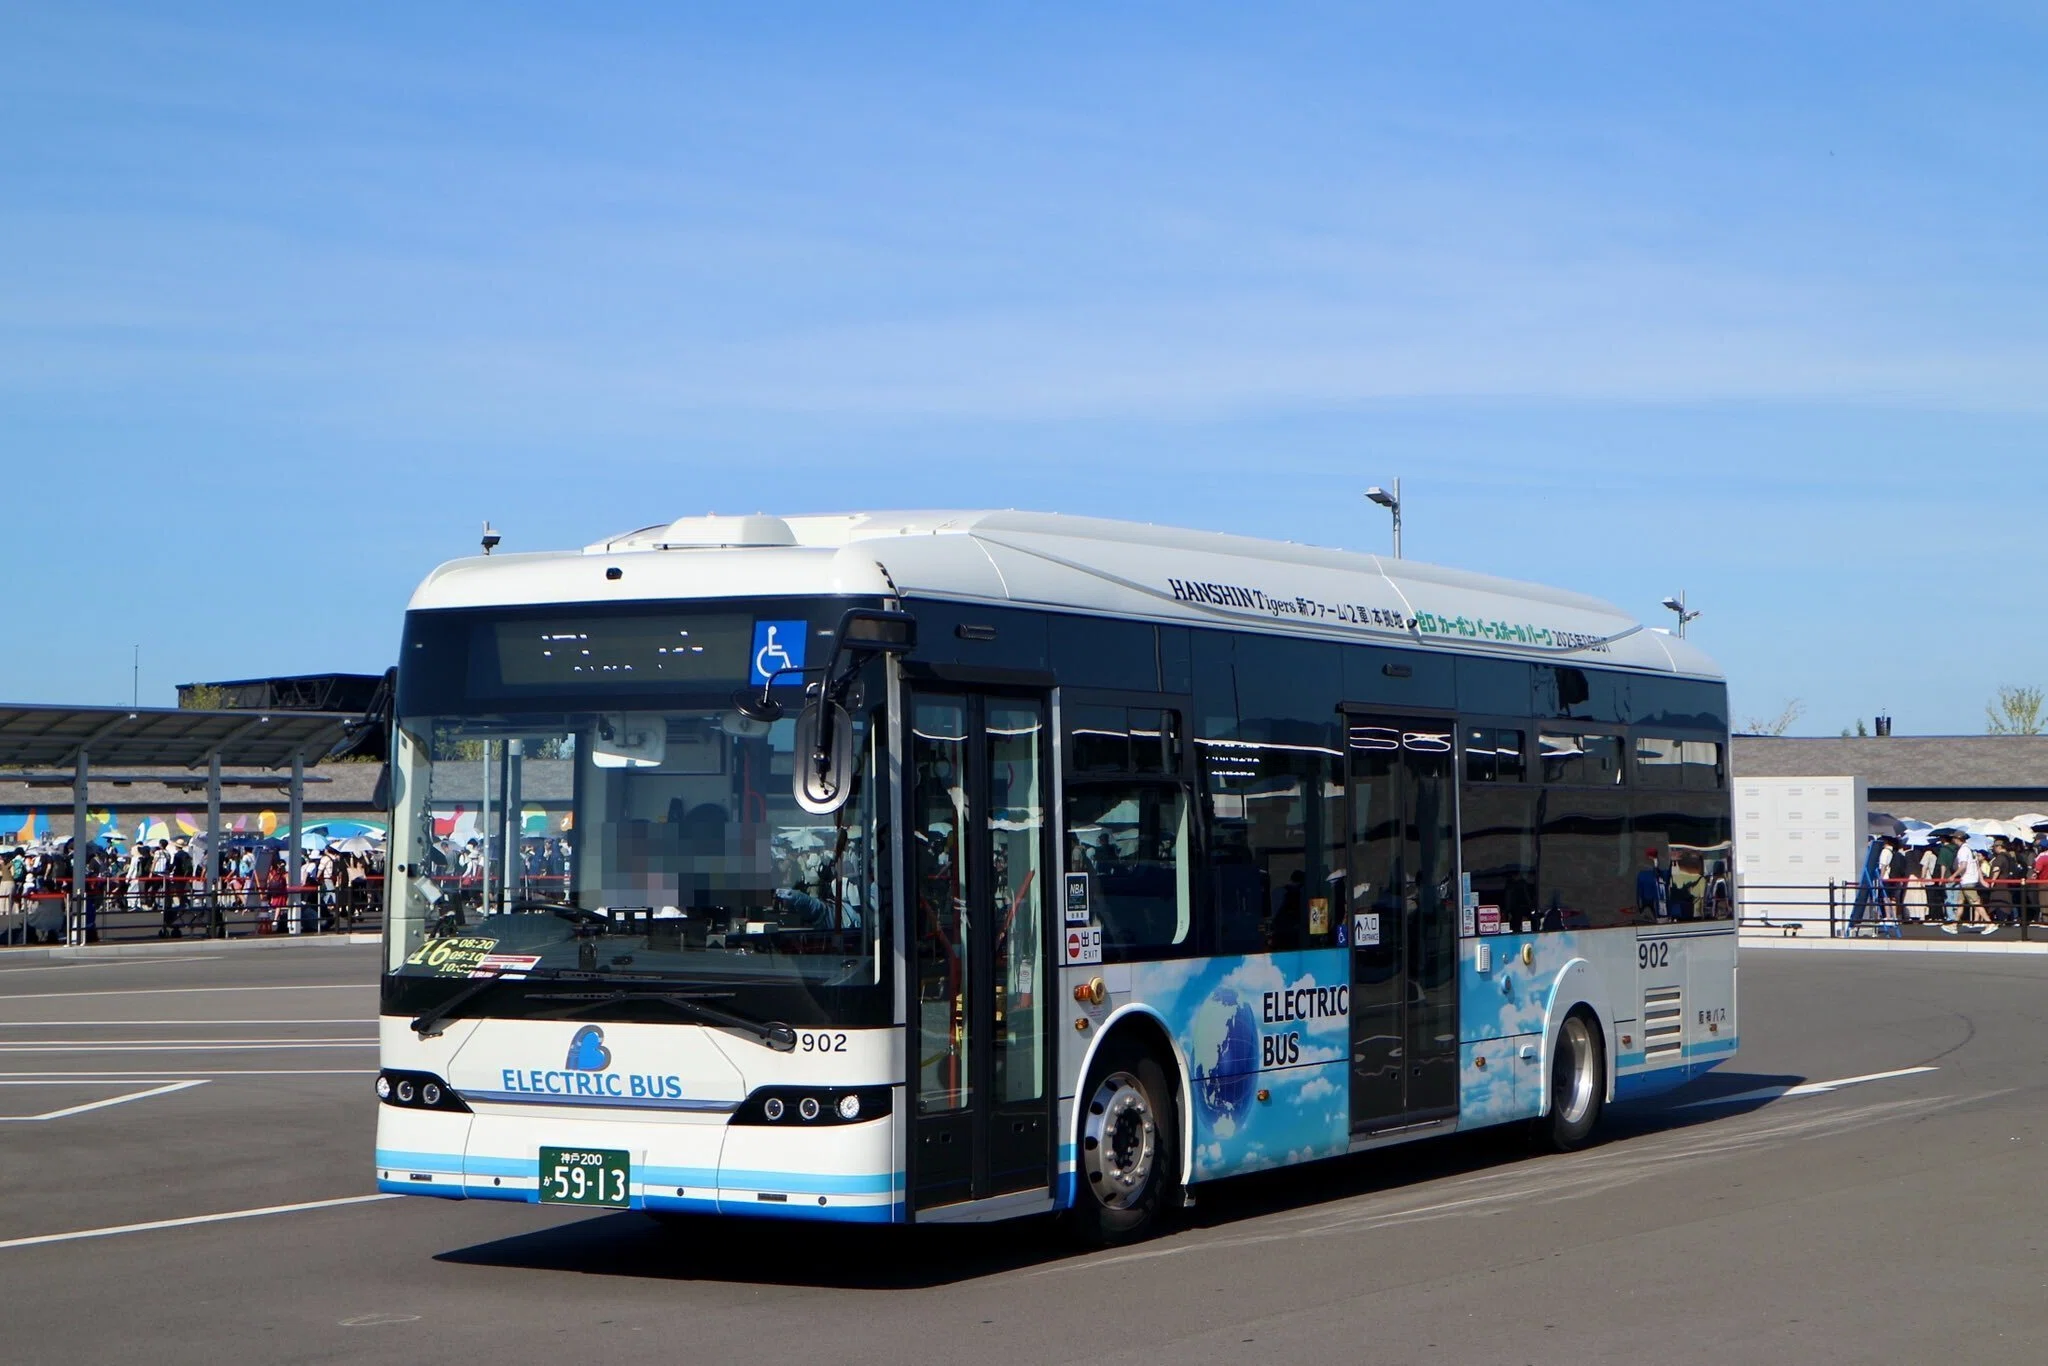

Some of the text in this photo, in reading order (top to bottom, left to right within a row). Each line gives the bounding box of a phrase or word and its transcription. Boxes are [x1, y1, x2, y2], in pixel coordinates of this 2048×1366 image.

[1168, 578, 1256, 608] HANSHIN
[1253, 588, 1296, 616] Tigers
[1363, 916, 1377, 930] 入口
[407, 938, 458, 966] 16
[459, 938, 495, 950] 08:20
[1081, 930, 1100, 947] 出口
[450, 950, 485, 962] 09:10
[1083, 950, 1098, 959] EXIT
[1638, 941, 1668, 969] 902
[1263, 985, 1348, 1023] ELECTRIC
[802, 1033, 847, 1052] 902
[1263, 1032, 1299, 1067] BUS
[502, 1069, 682, 1098] ELECTRIC BUS
[554, 1166, 625, 1201] 59-13
